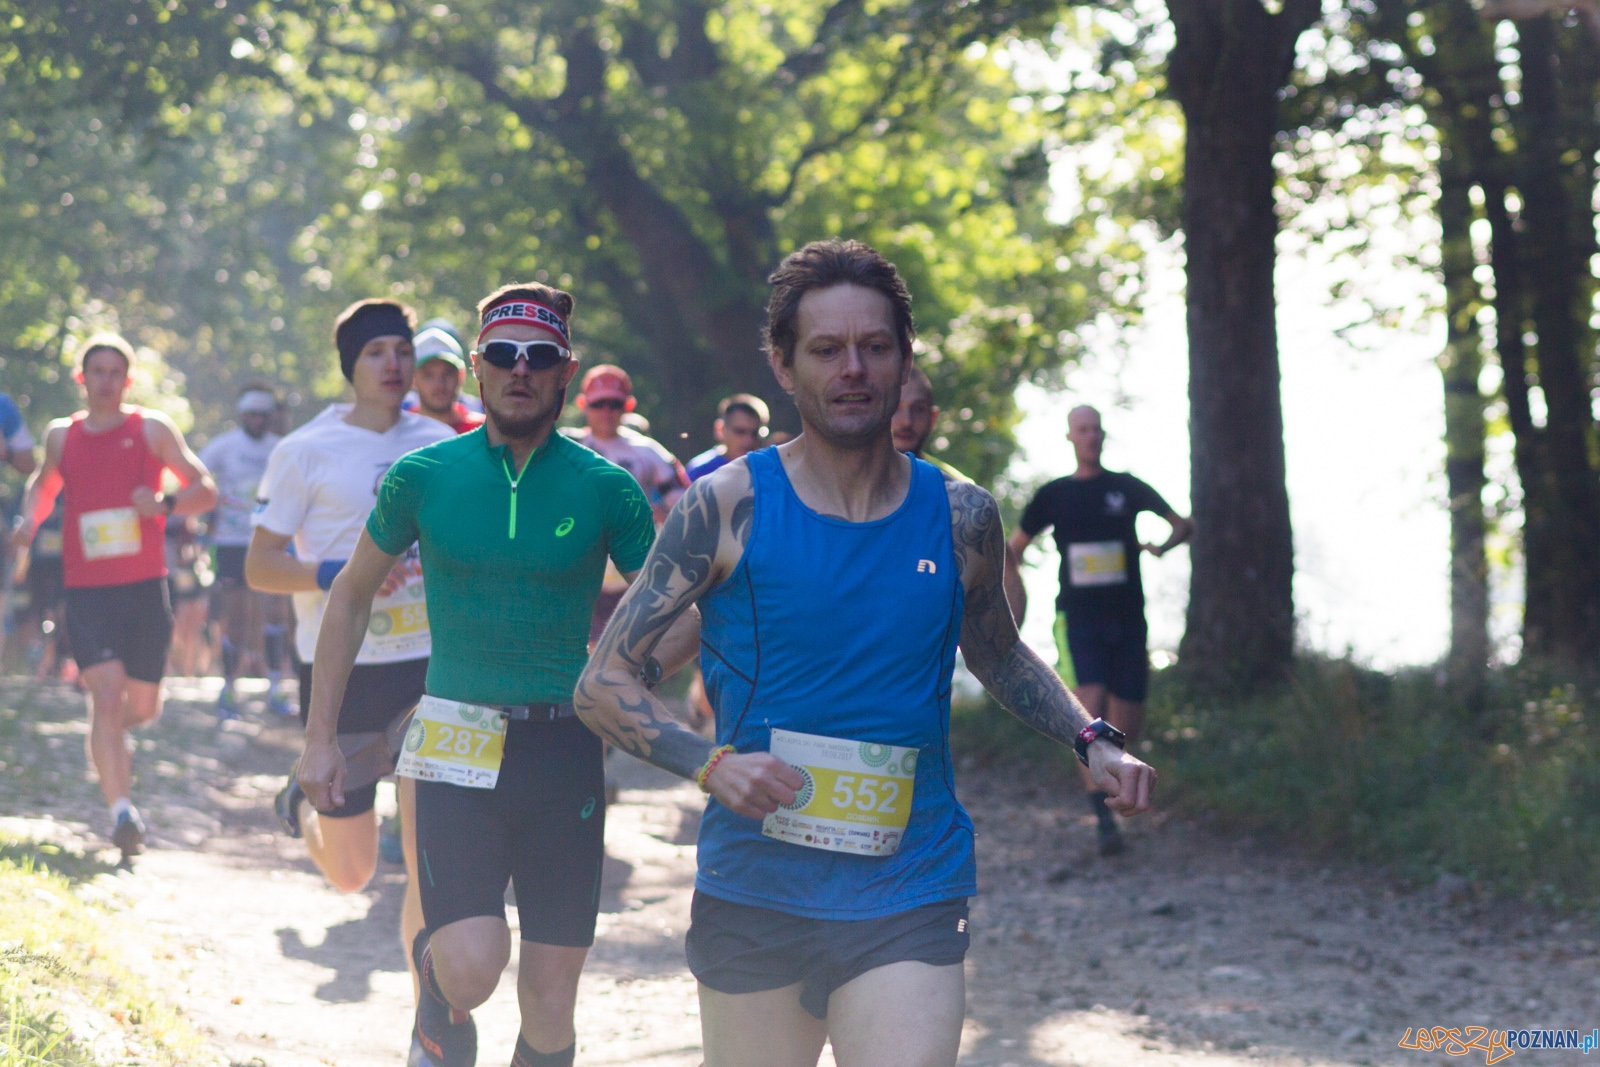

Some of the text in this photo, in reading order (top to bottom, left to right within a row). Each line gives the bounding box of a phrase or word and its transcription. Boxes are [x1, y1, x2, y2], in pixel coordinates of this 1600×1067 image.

[483, 304, 569, 339] MPRESSPO
[435, 725, 491, 758] 287
[813, 741, 826, 750] PARK
[831, 775, 900, 814] 552
[845, 812, 880, 823] DOMINIK
